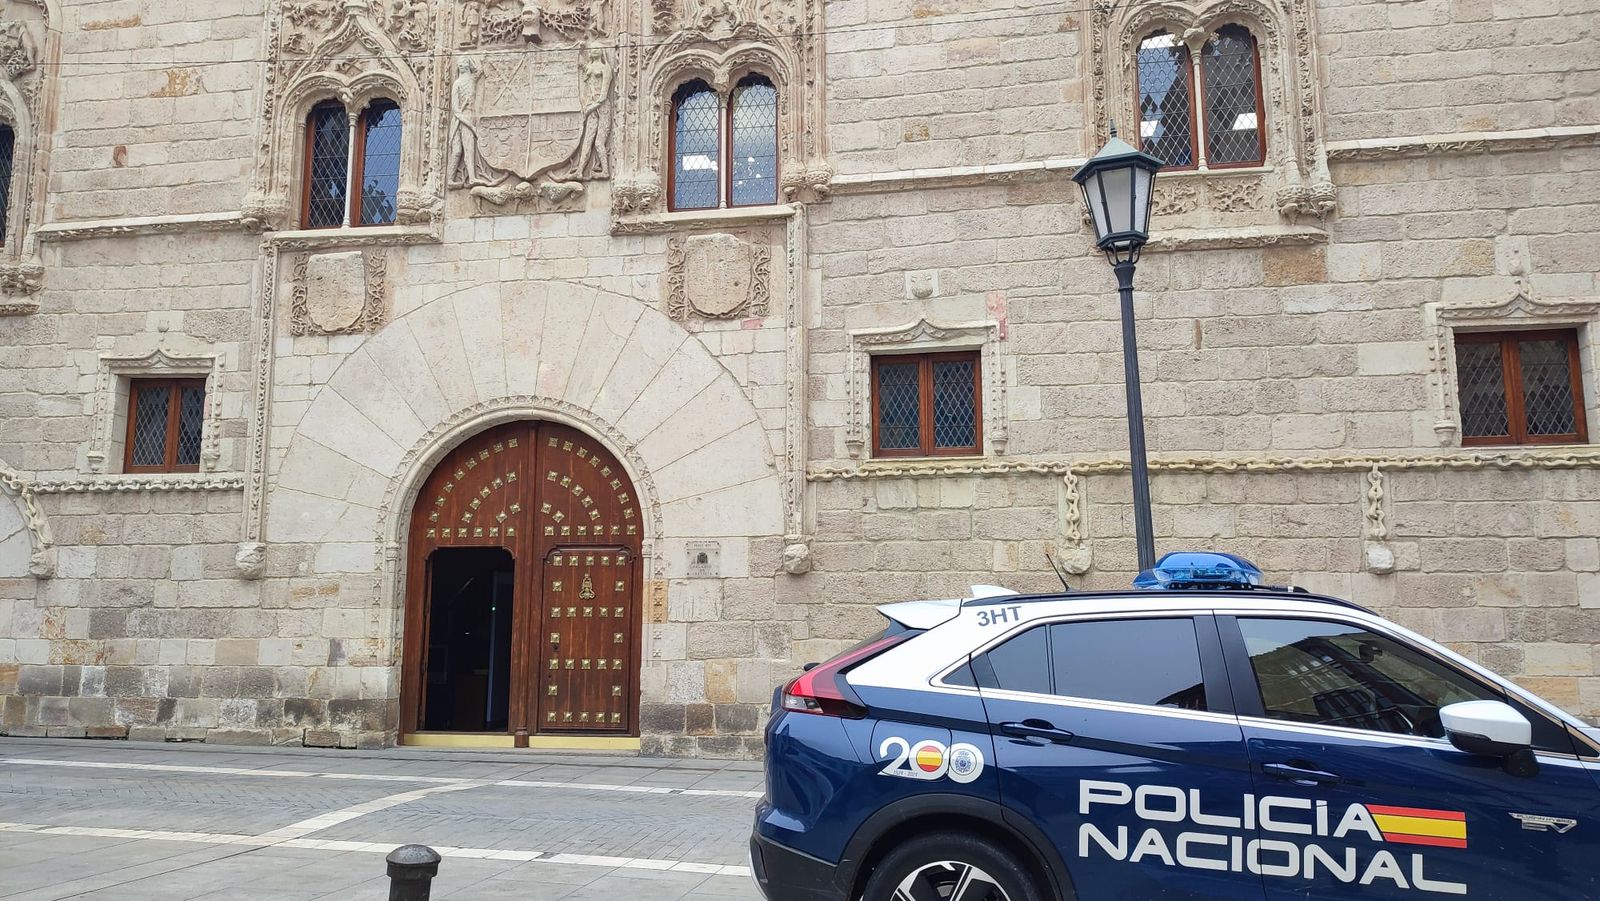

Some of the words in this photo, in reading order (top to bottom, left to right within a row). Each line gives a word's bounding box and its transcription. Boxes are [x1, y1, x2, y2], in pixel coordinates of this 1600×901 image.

[976, 606, 1022, 627] 3HT
[877, 736, 984, 784] 200
[1079, 822, 1467, 895] NACIONAL
